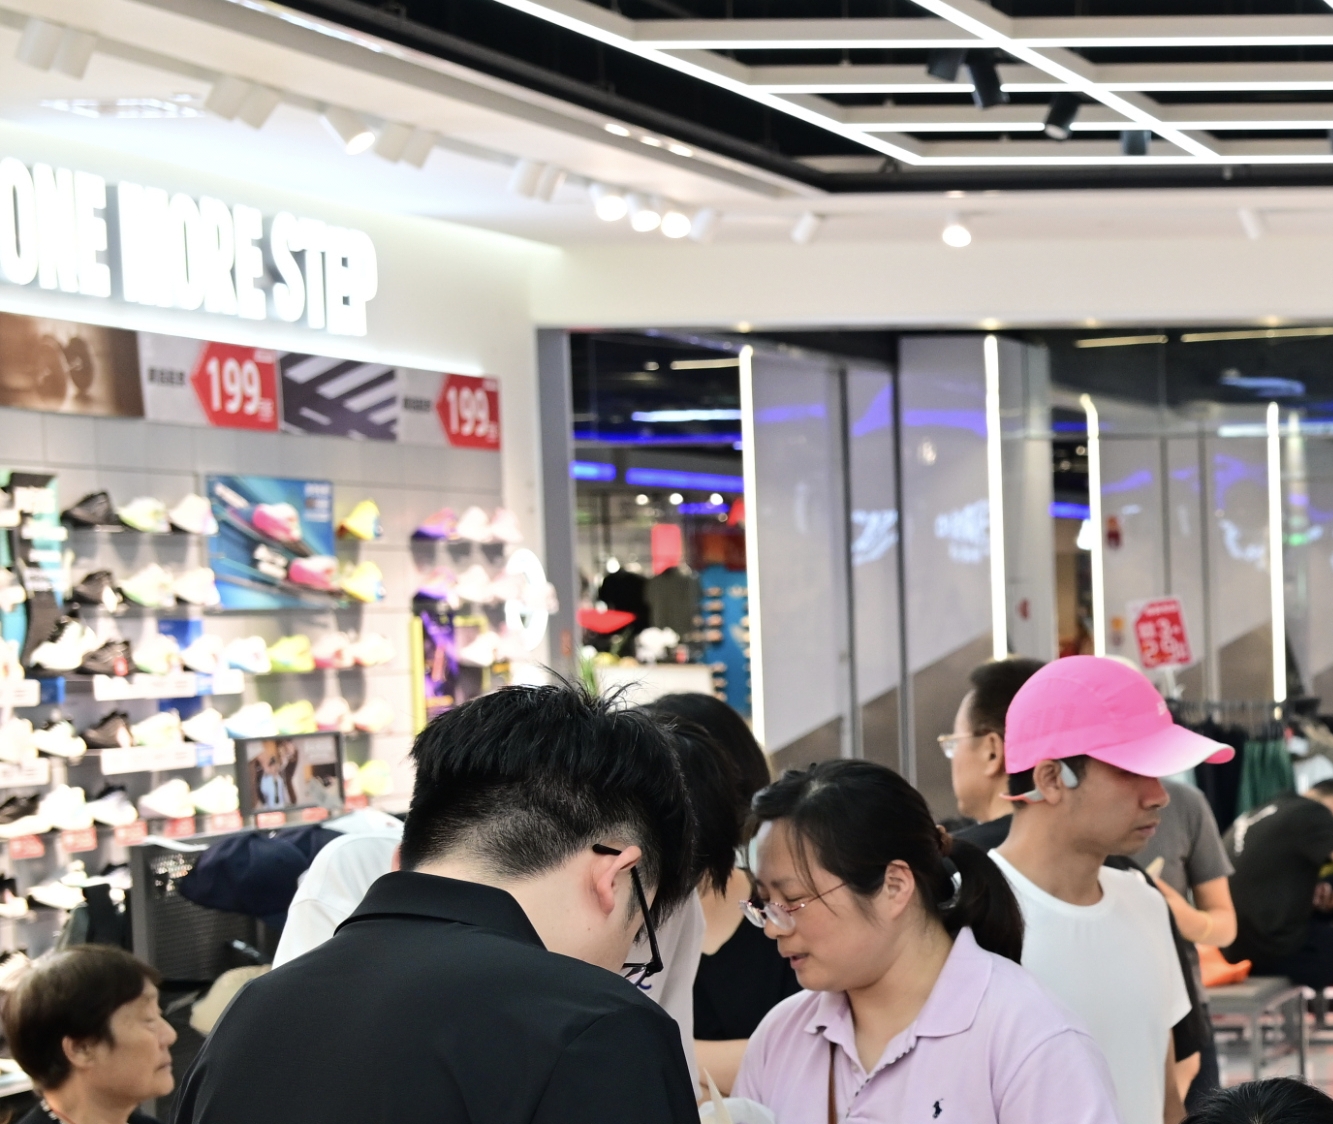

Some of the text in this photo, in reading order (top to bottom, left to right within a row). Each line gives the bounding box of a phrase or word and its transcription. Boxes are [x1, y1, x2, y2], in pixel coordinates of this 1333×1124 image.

[0, 157, 378, 337] ONE MORE STEP
[205, 357, 262, 415] 199
[445, 387, 491, 437] 199
